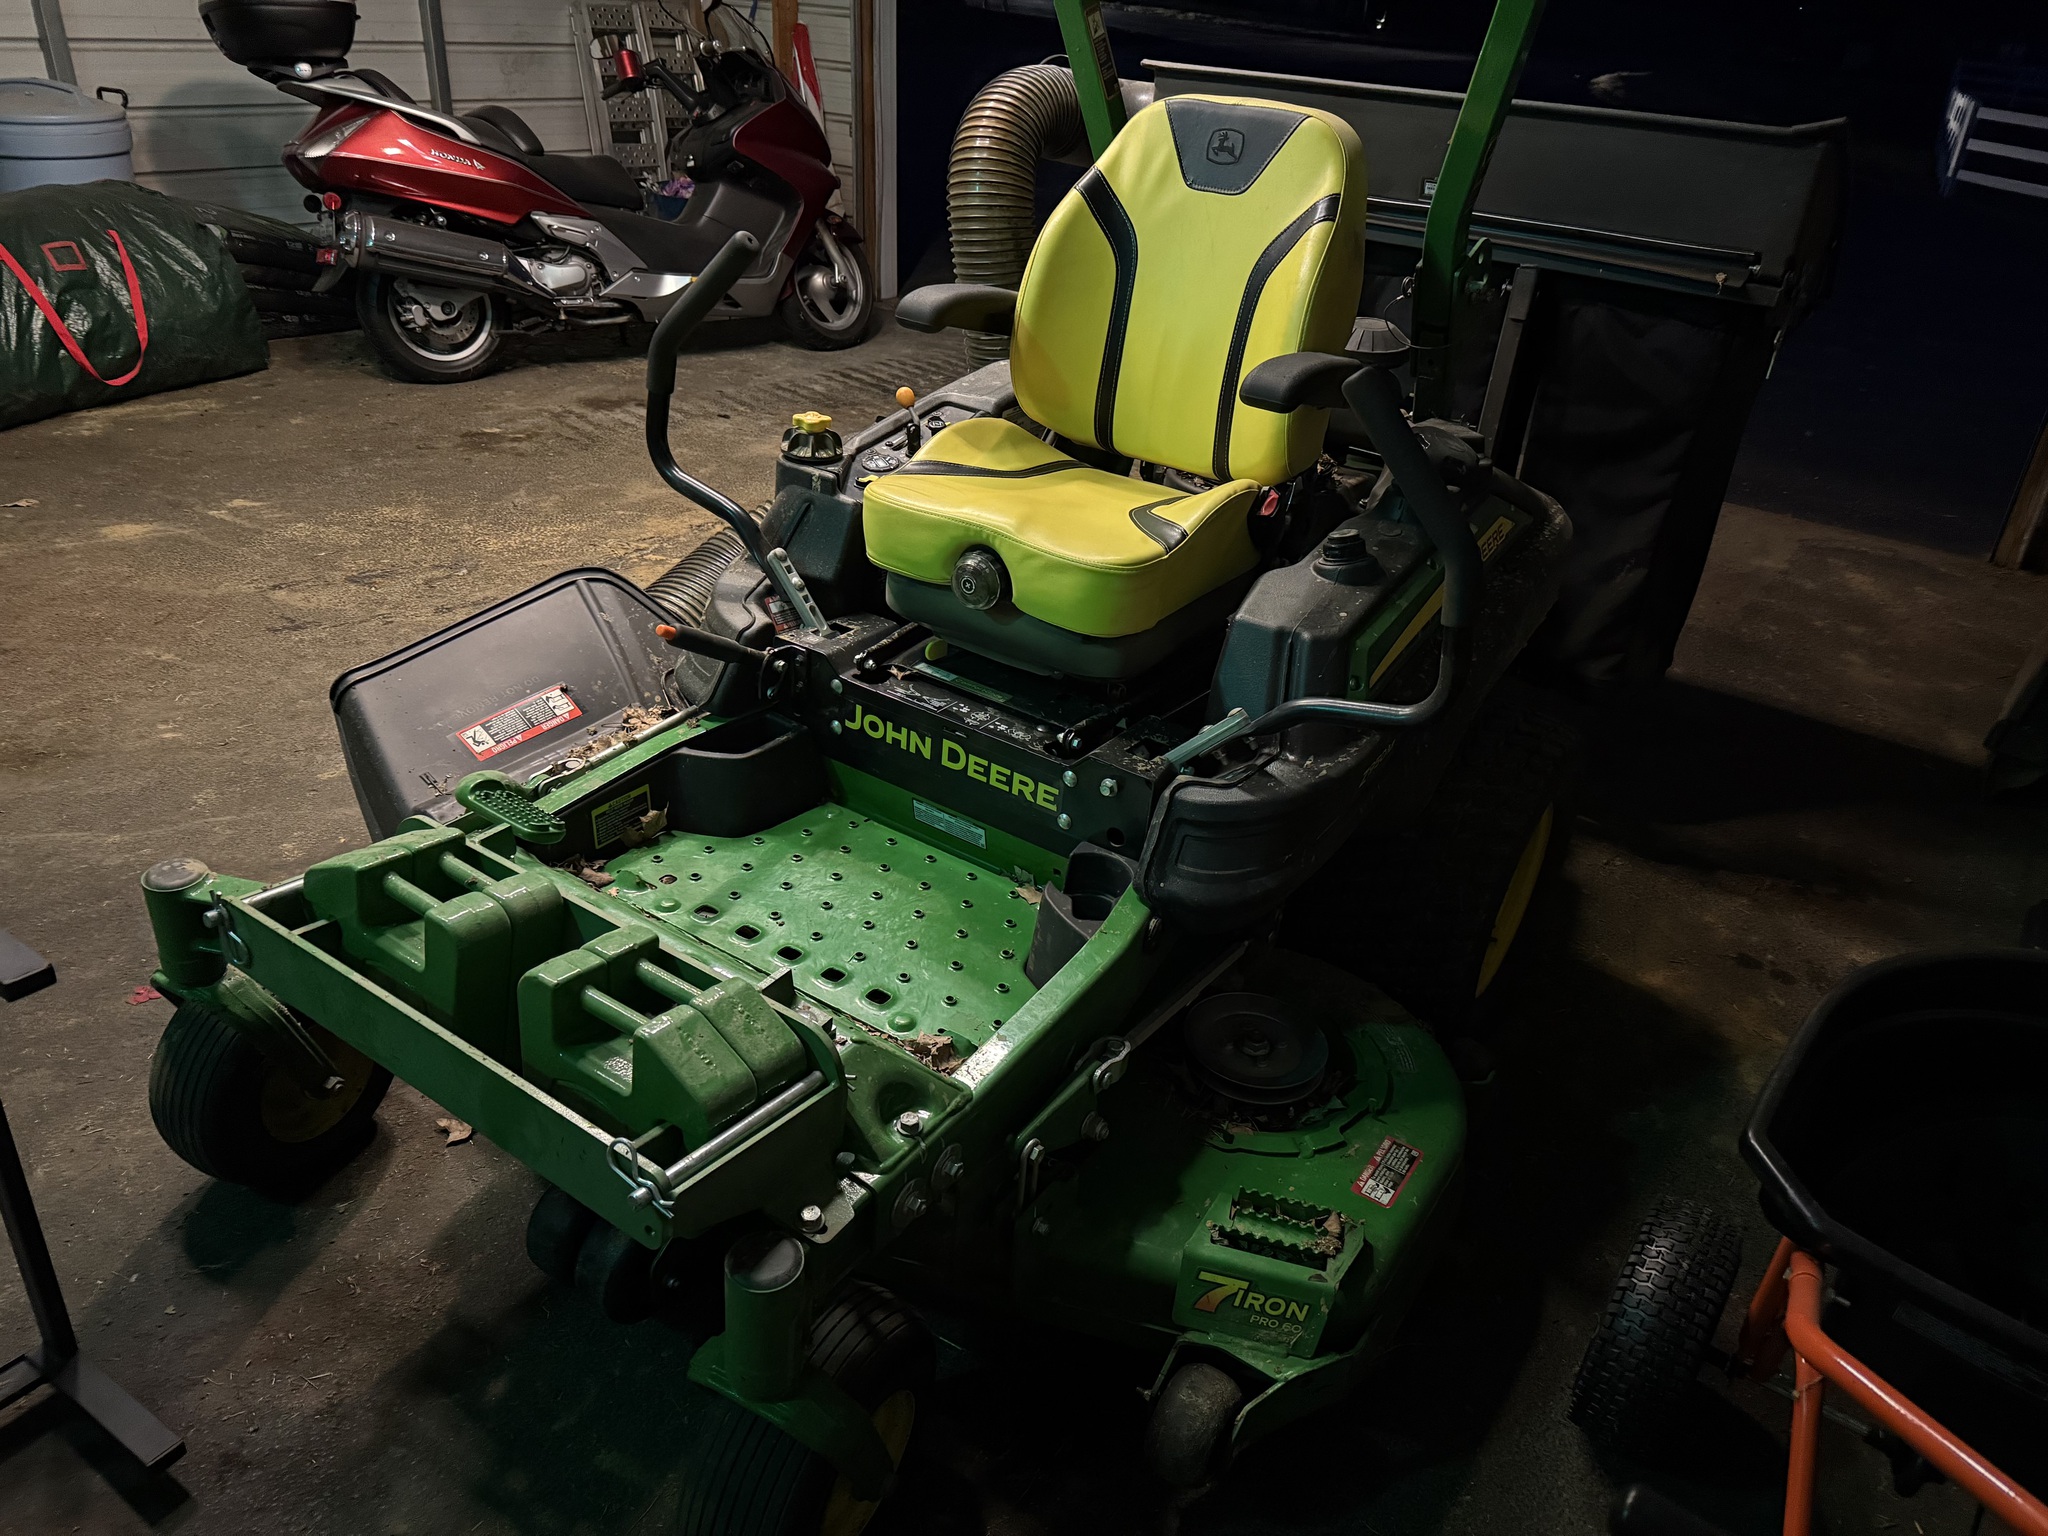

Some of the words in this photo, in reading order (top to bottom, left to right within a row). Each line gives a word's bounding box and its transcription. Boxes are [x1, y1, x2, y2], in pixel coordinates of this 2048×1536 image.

[431, 148, 472, 166] HONDA
[541, 715, 565, 730] DANGER
[491, 736, 517, 753] PELIGRO
[845, 703, 932, 760] JOHN
[941, 738, 1060, 812] DEERE
[1249, 1315, 1279, 1329] PRO
